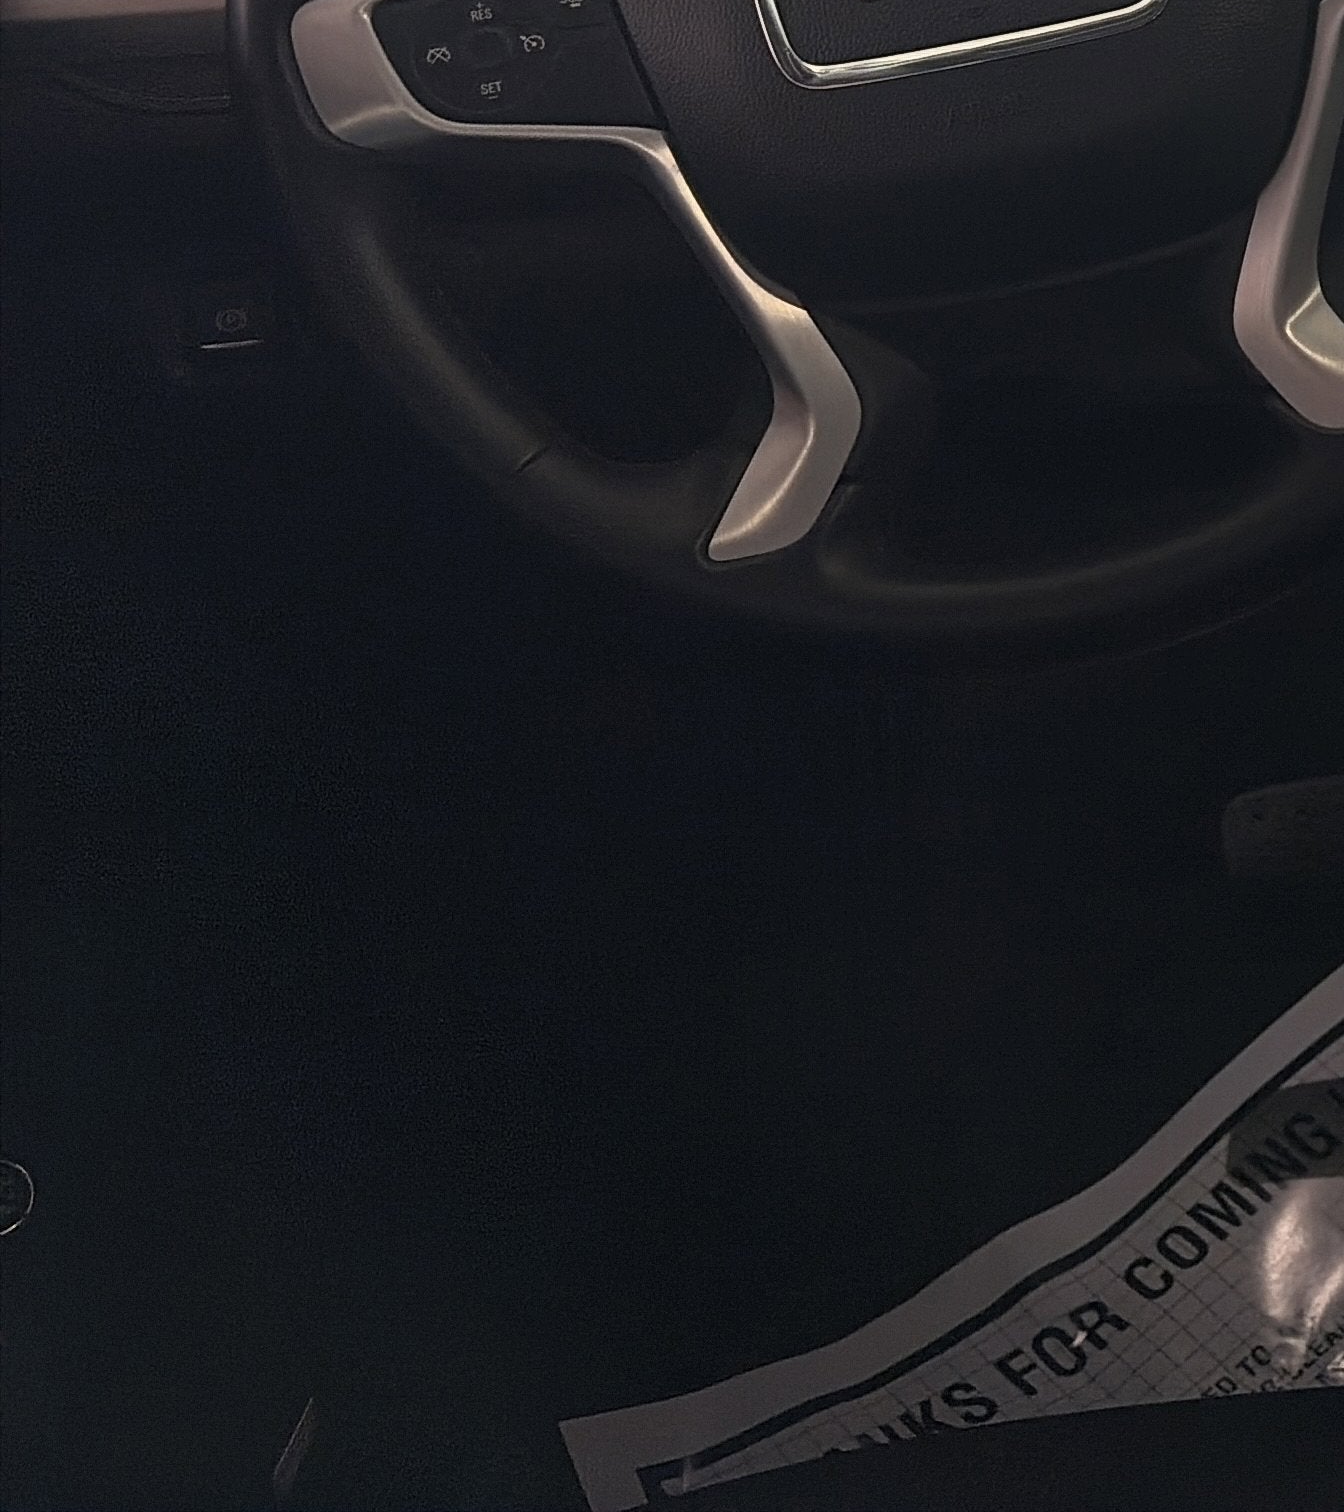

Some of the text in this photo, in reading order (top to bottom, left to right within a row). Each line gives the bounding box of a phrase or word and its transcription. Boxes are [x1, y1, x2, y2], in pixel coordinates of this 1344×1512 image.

[470, 7, 493, 23] RES
[480, 81, 502, 97] SET
[993, 1300, 1129, 1397] FOR
[1124, 1112, 1343, 1301] COMING
[1236, 1345, 1271, 1377] TO
